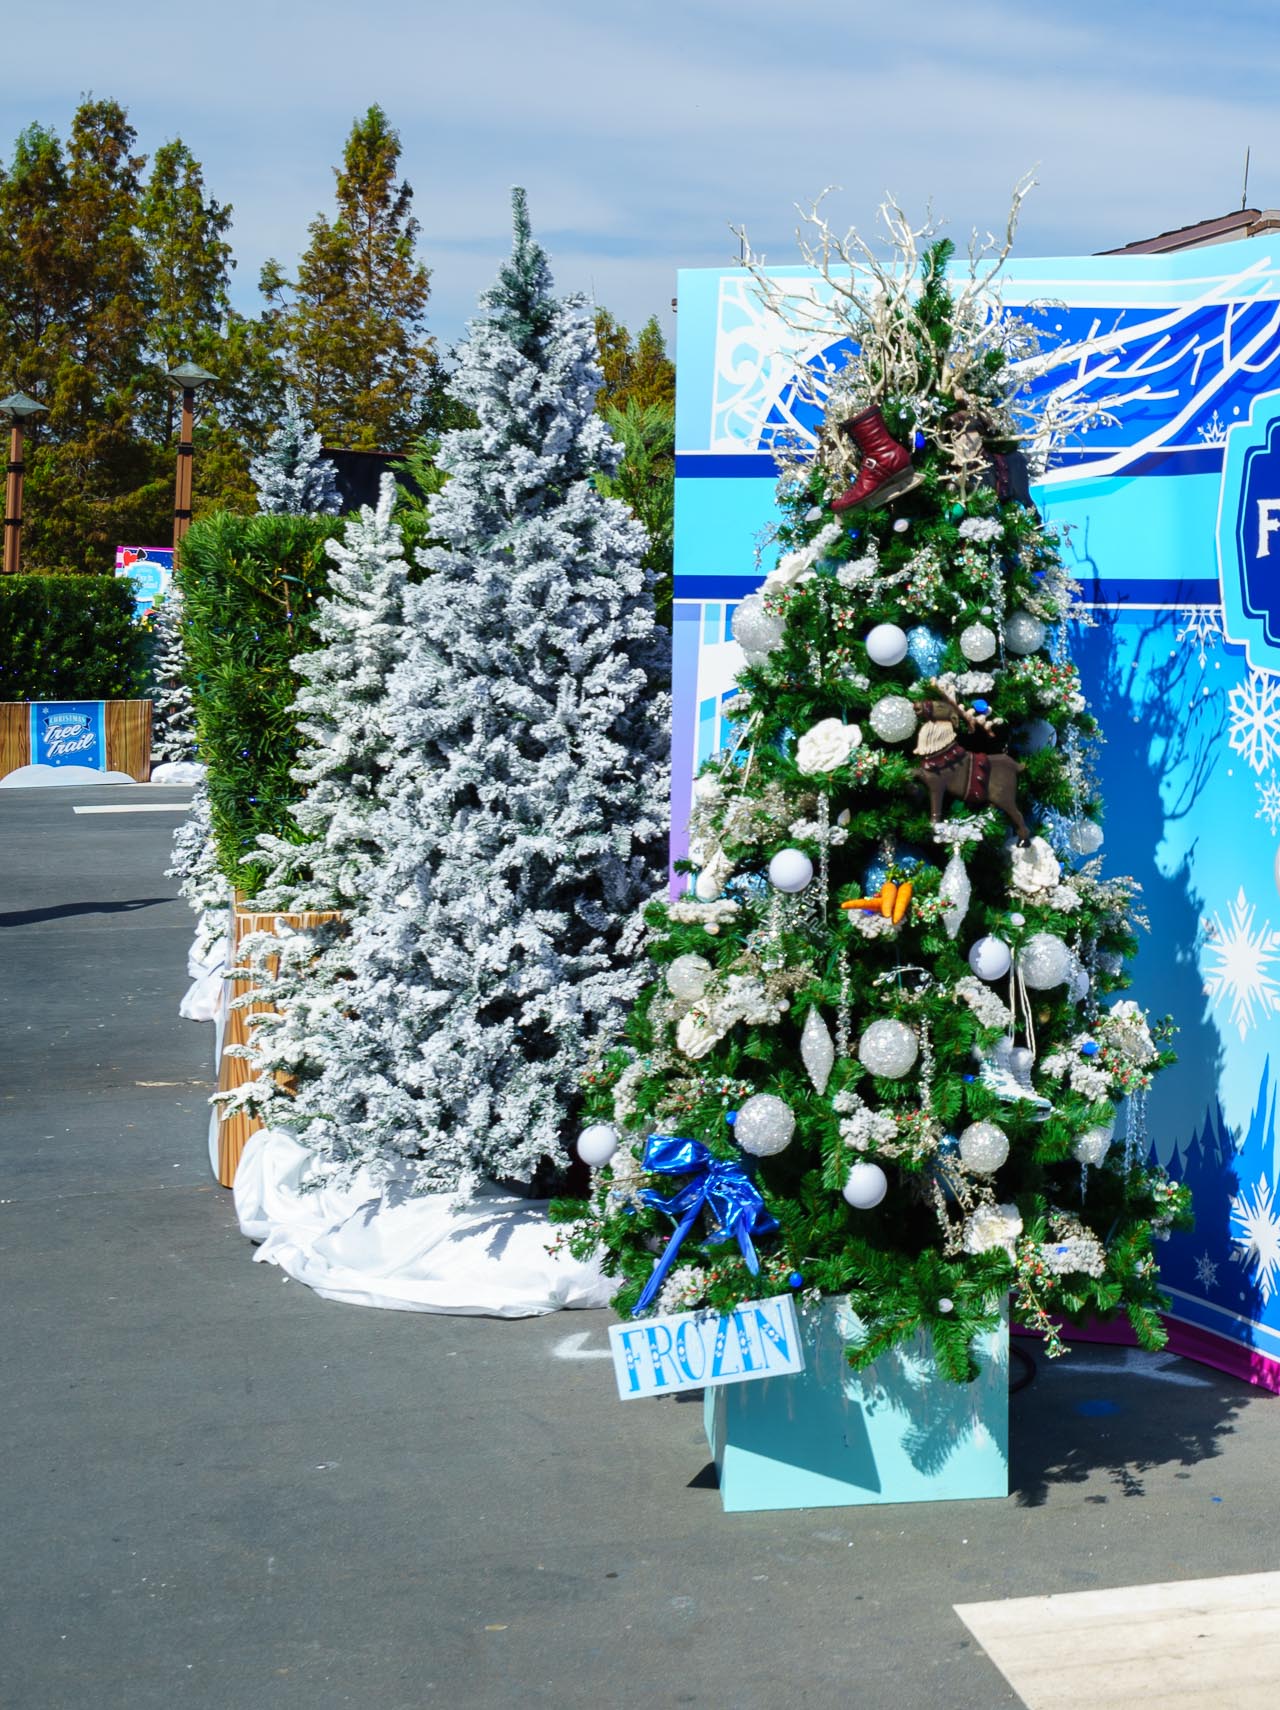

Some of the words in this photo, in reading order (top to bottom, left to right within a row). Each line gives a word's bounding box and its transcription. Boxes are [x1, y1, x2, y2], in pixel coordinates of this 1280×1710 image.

[43, 724, 82, 742] Tree
[46, 733, 94, 758] Trail
[619, 1304, 791, 1392] FROZEN
